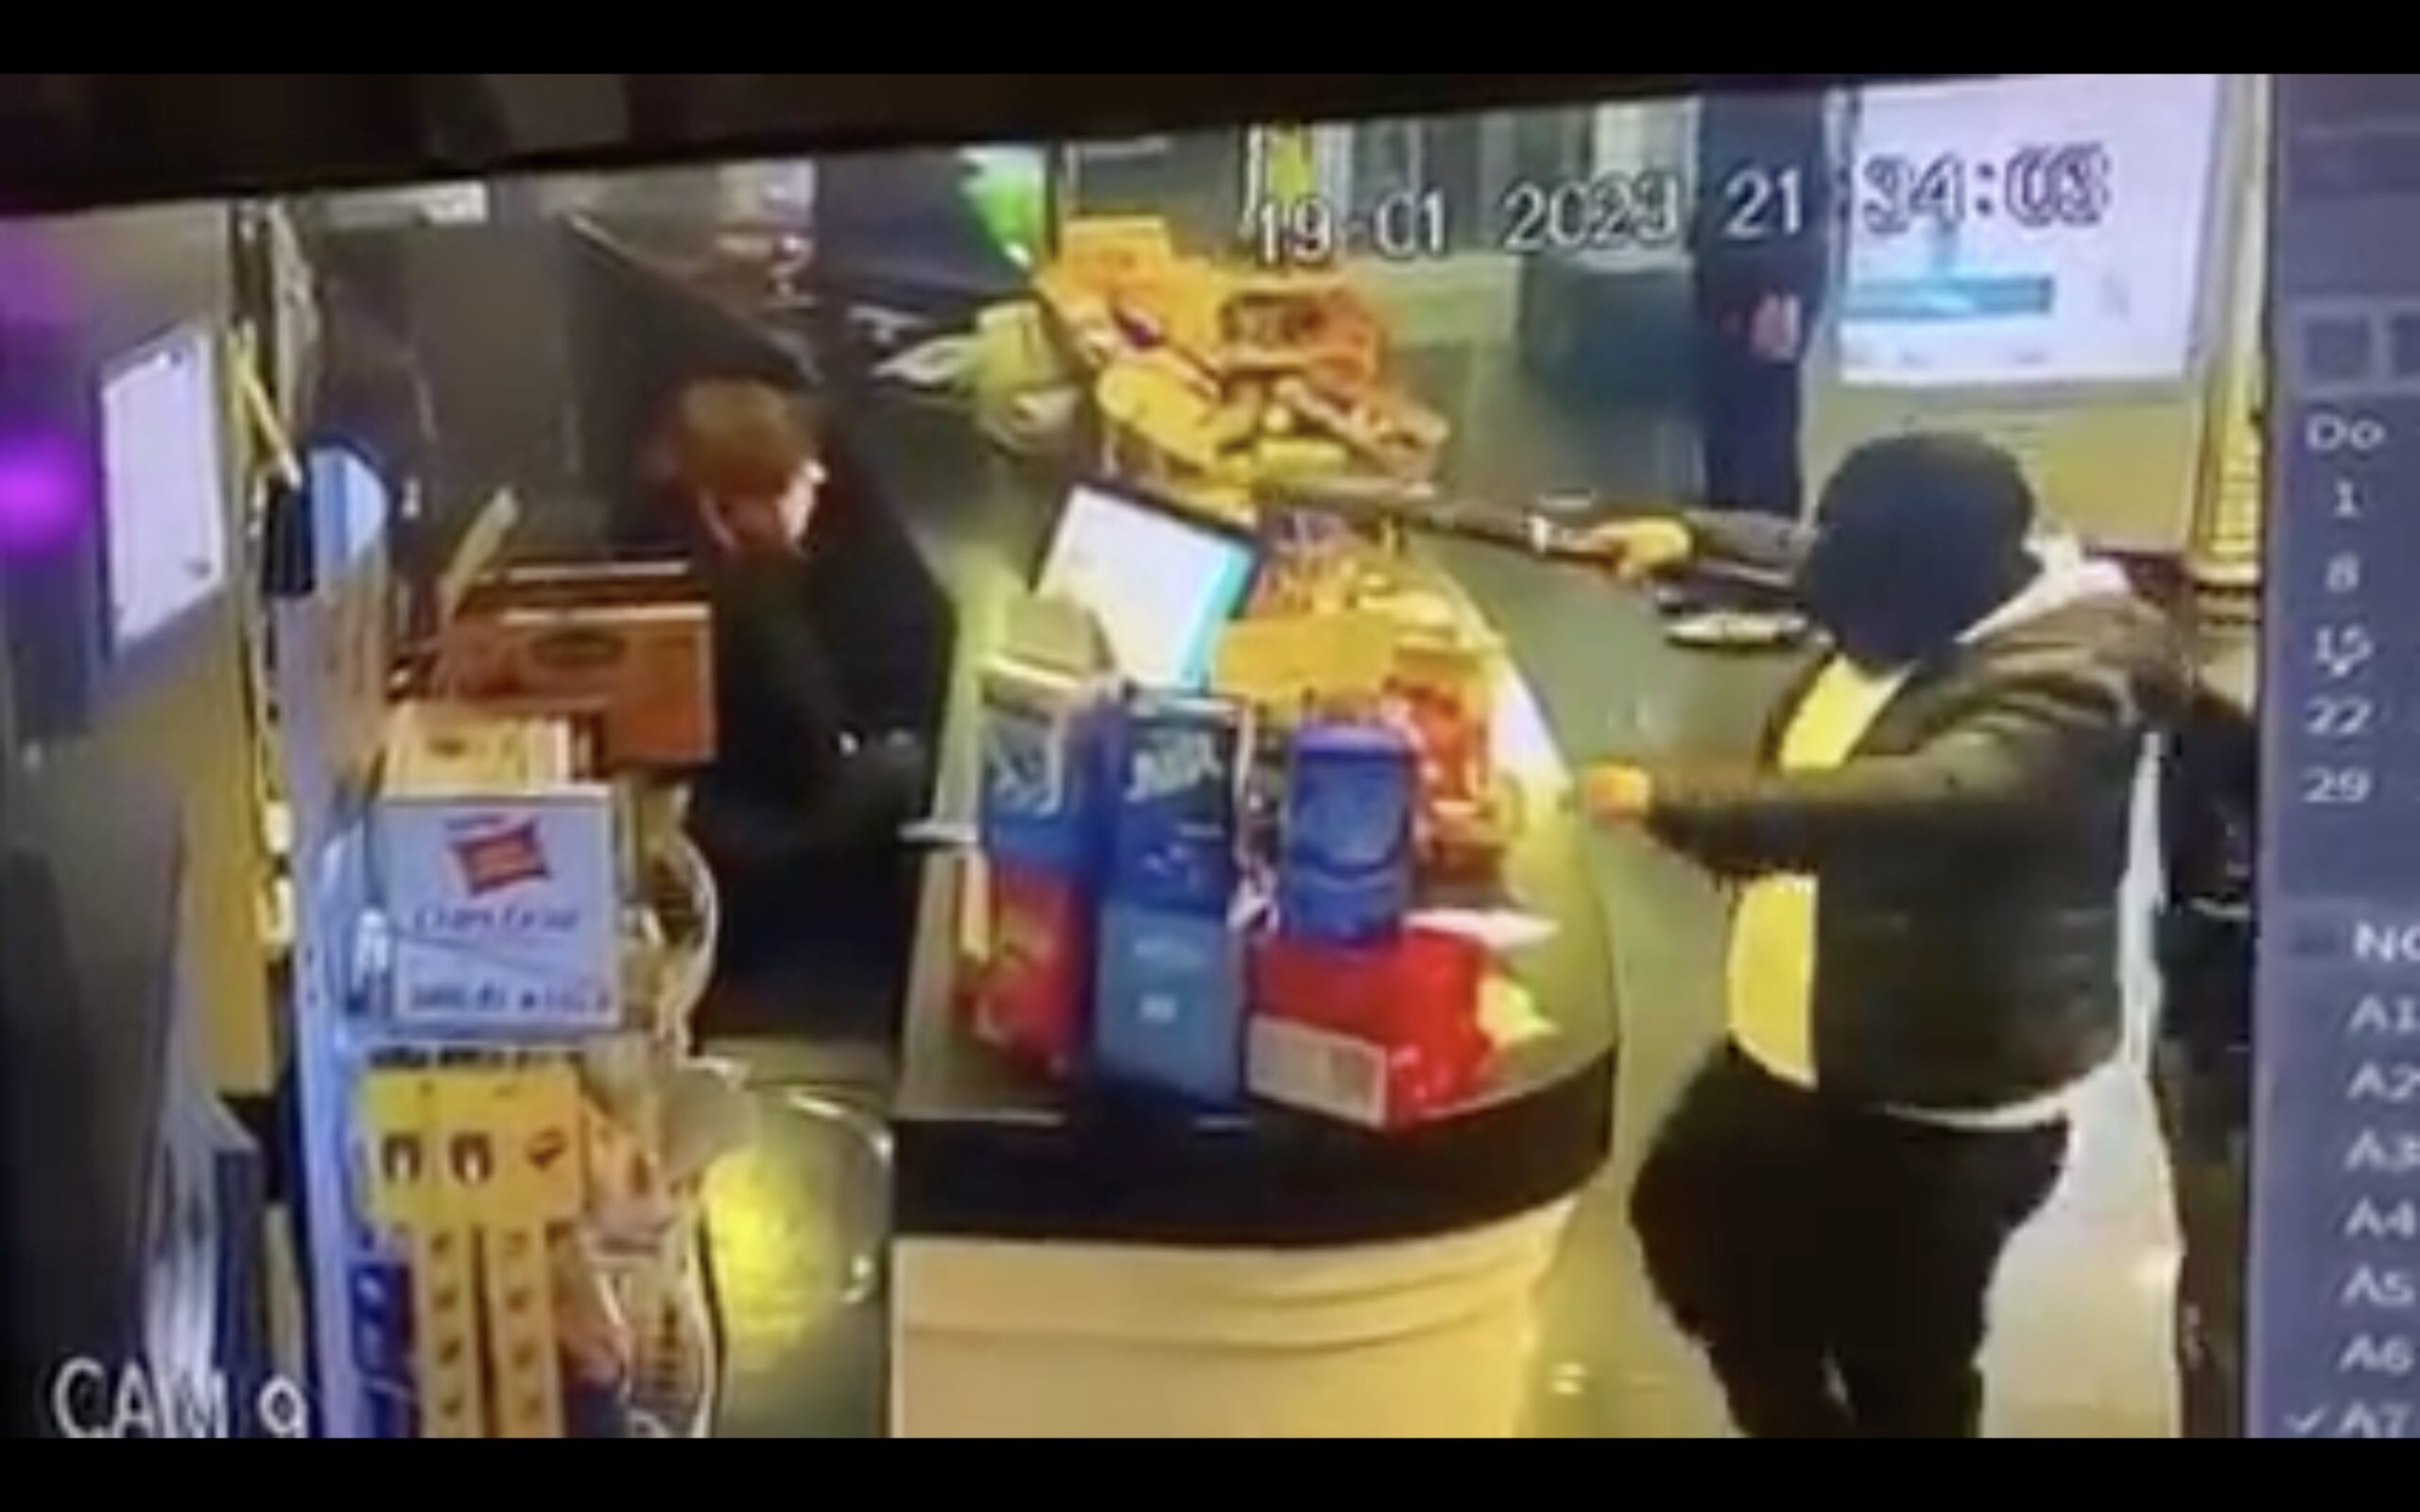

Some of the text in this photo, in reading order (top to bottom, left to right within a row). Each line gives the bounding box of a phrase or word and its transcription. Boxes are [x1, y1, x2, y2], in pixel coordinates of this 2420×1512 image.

[2306, 414, 2384, 451] Do
[2334, 481, 2358, 517] 1
[2315, 626, 2373, 665] 15
[2306, 700, 2371, 735] 22
[2303, 767, 2371, 803] 29
[2343, 1194, 2417, 1237] A4
[2340, 1263, 2416, 1307] A5
[2338, 1333, 2415, 1375] A6
